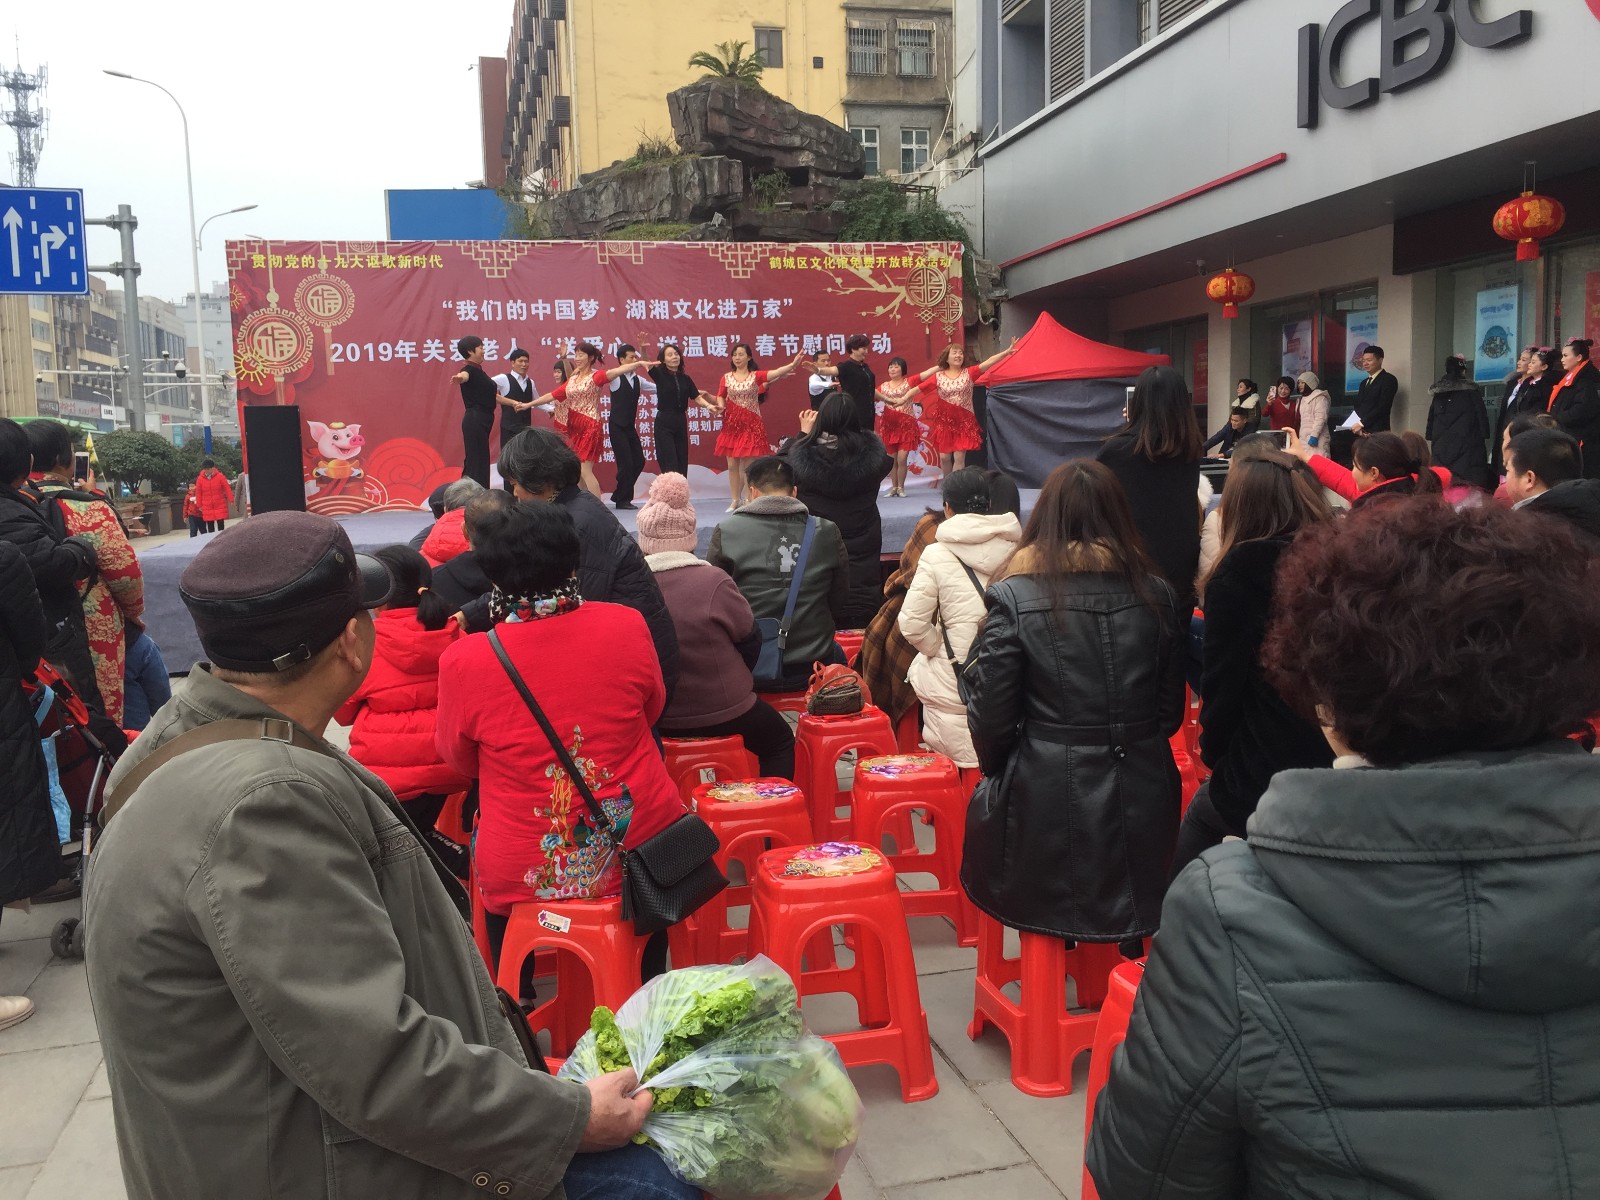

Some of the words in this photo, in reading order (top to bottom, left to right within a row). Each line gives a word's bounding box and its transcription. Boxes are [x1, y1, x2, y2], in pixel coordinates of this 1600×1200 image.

[250, 254, 444, 269] 贯彻党的十九大讴歌新时代
[769, 255, 952, 270] 鹤城区文化馆免费开放群众活动
